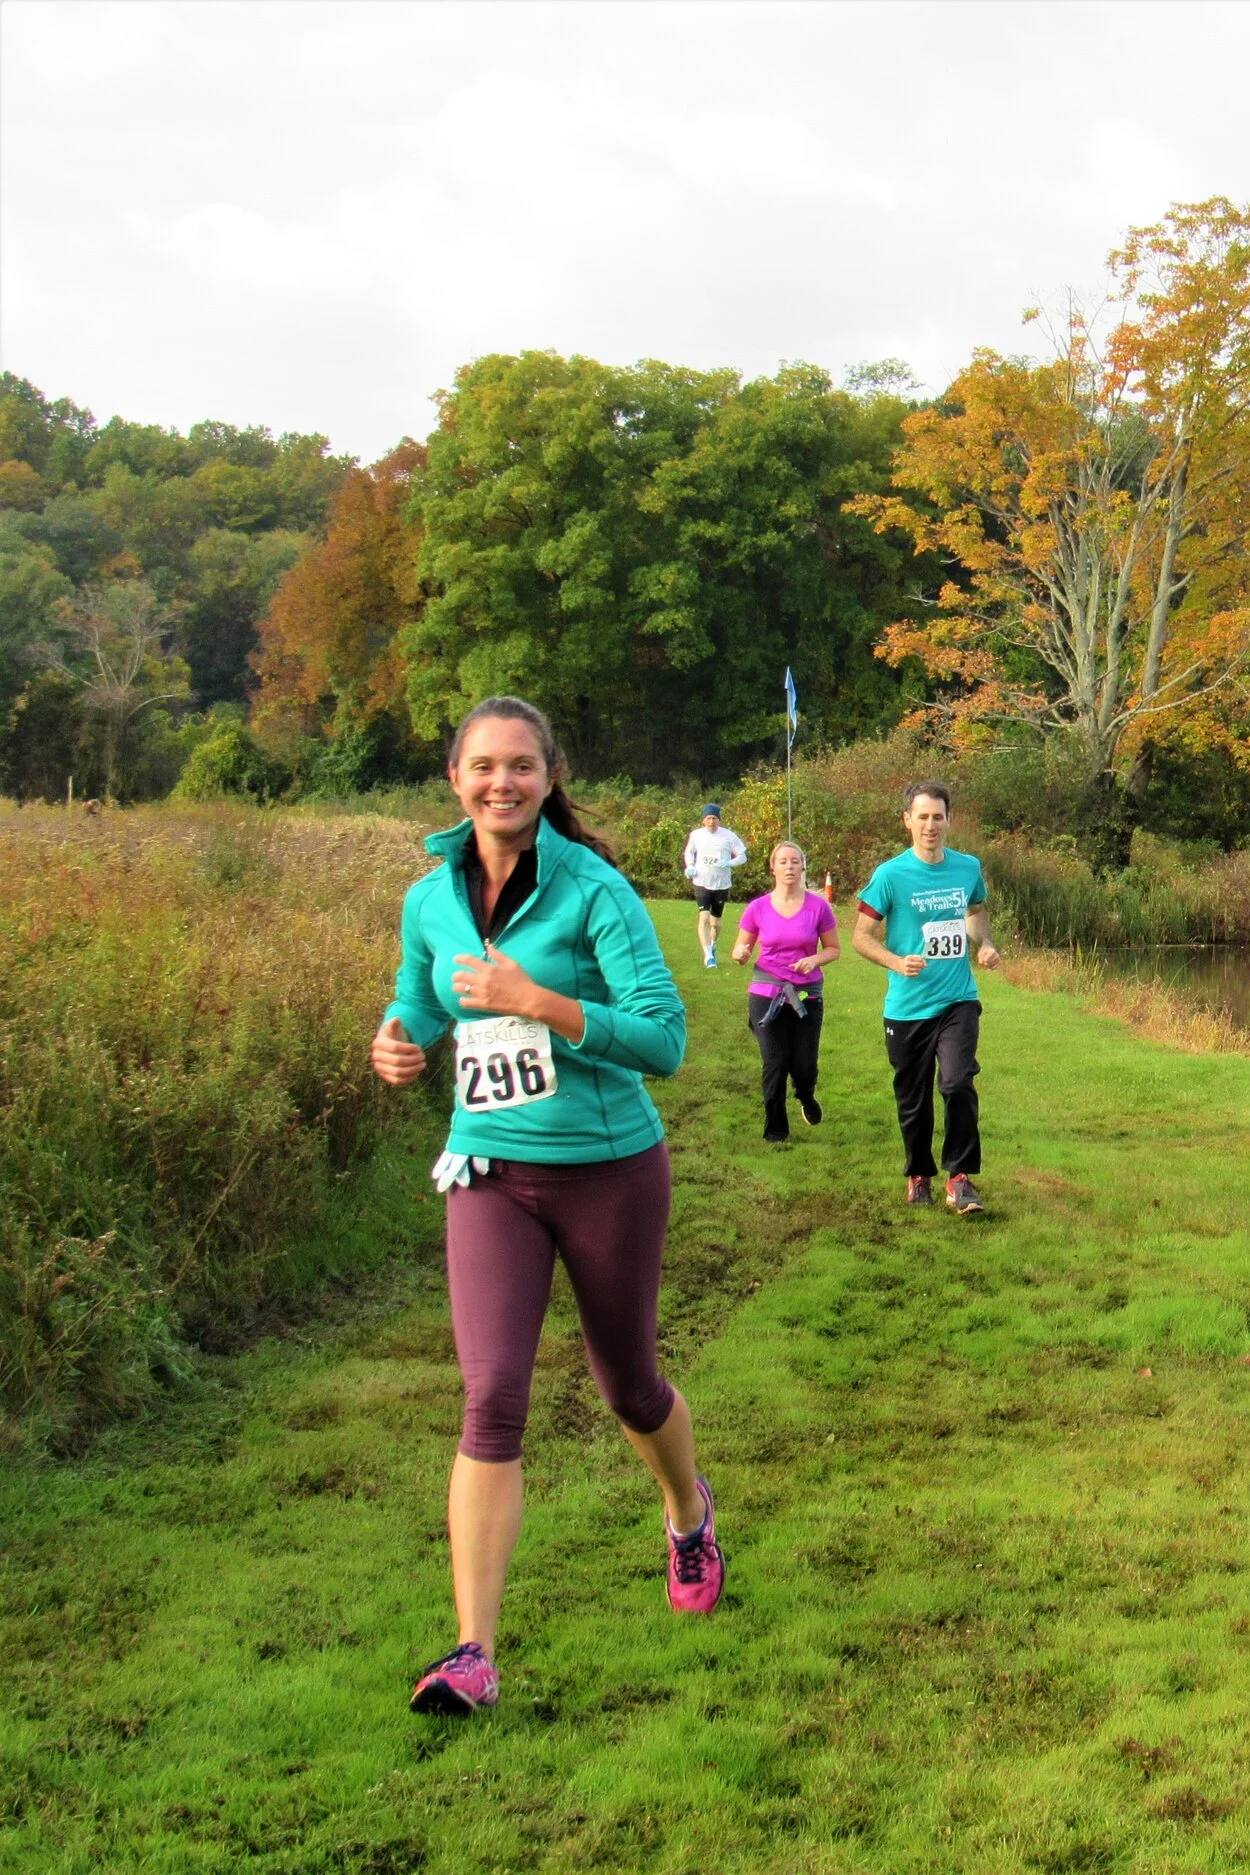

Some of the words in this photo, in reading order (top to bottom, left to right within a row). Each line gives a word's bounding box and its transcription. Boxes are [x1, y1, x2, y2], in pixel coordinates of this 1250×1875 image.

[911, 895, 953, 906] Meadows
[952, 890, 968, 907] 5k
[919, 904, 927, 912] &
[929, 900, 953, 911] Trails
[927, 934, 962, 956] 339
[461, 1047, 547, 1106] 296
